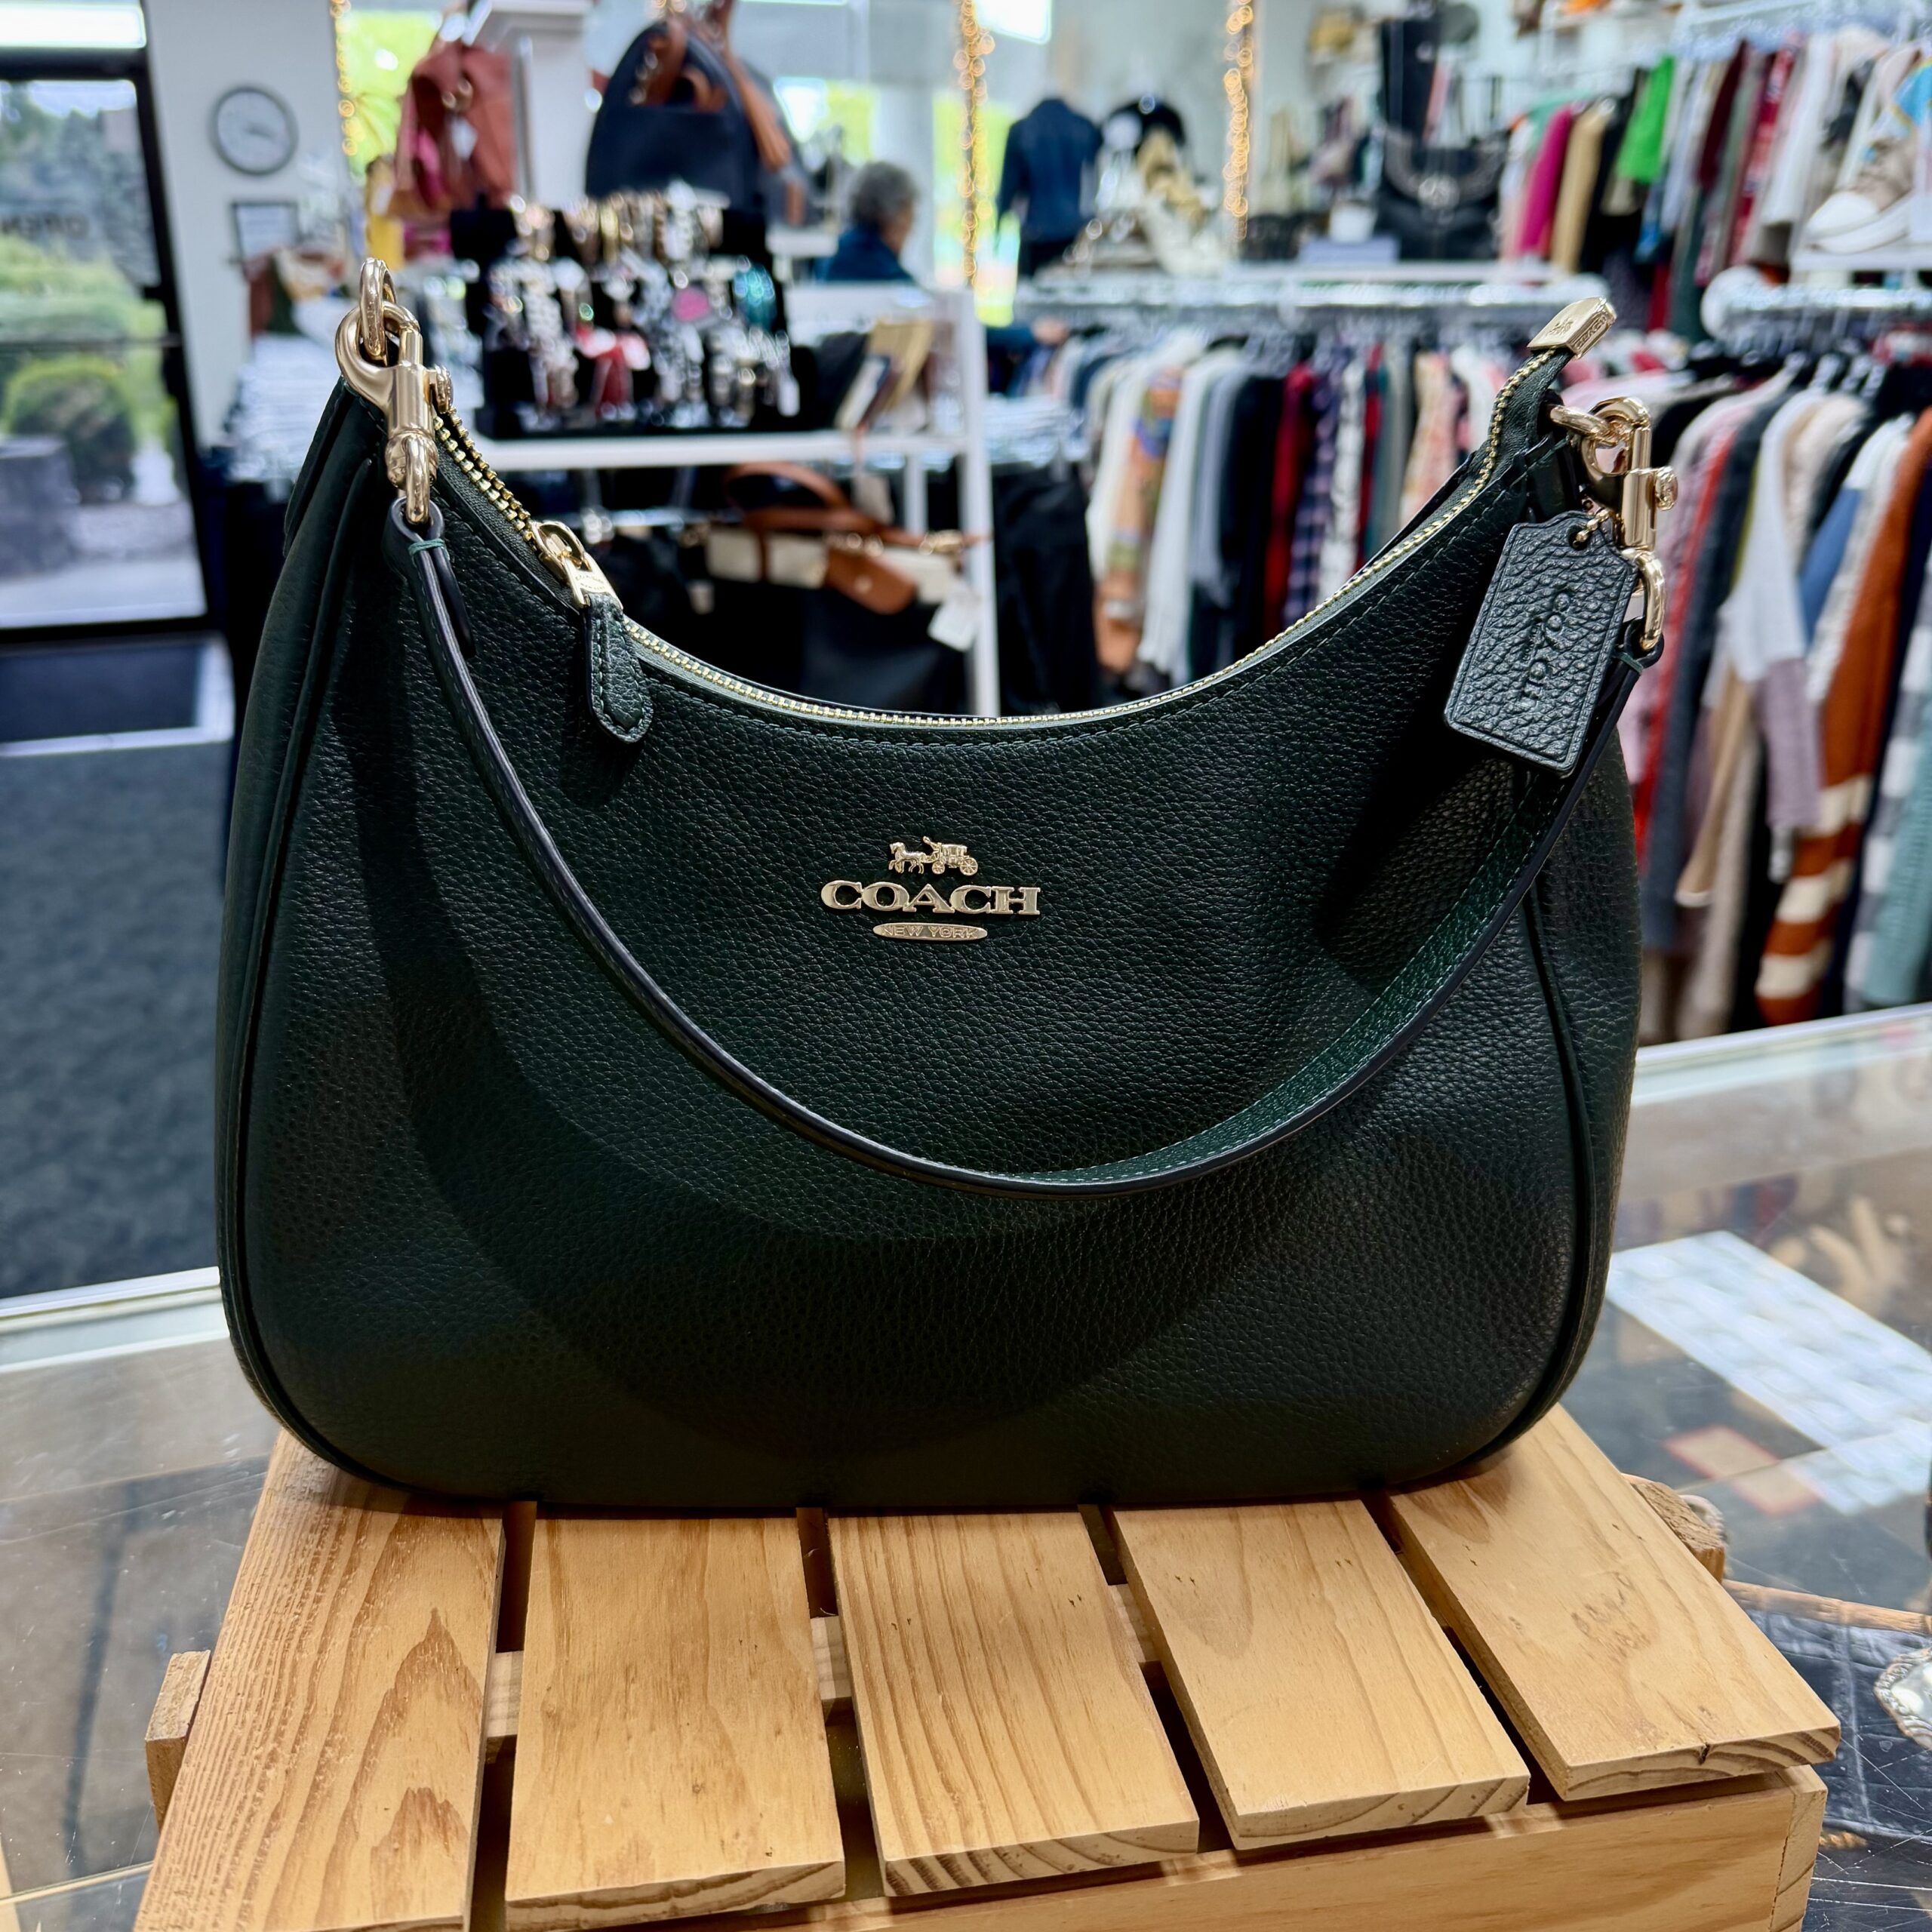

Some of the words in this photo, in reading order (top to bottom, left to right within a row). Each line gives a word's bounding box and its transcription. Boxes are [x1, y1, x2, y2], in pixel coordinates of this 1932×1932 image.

[1518, 589, 1574, 709] COACH
[821, 880, 1041, 915] COACH
[881, 925, 923, 936] NEW
[928, 926, 977, 939] YORK
